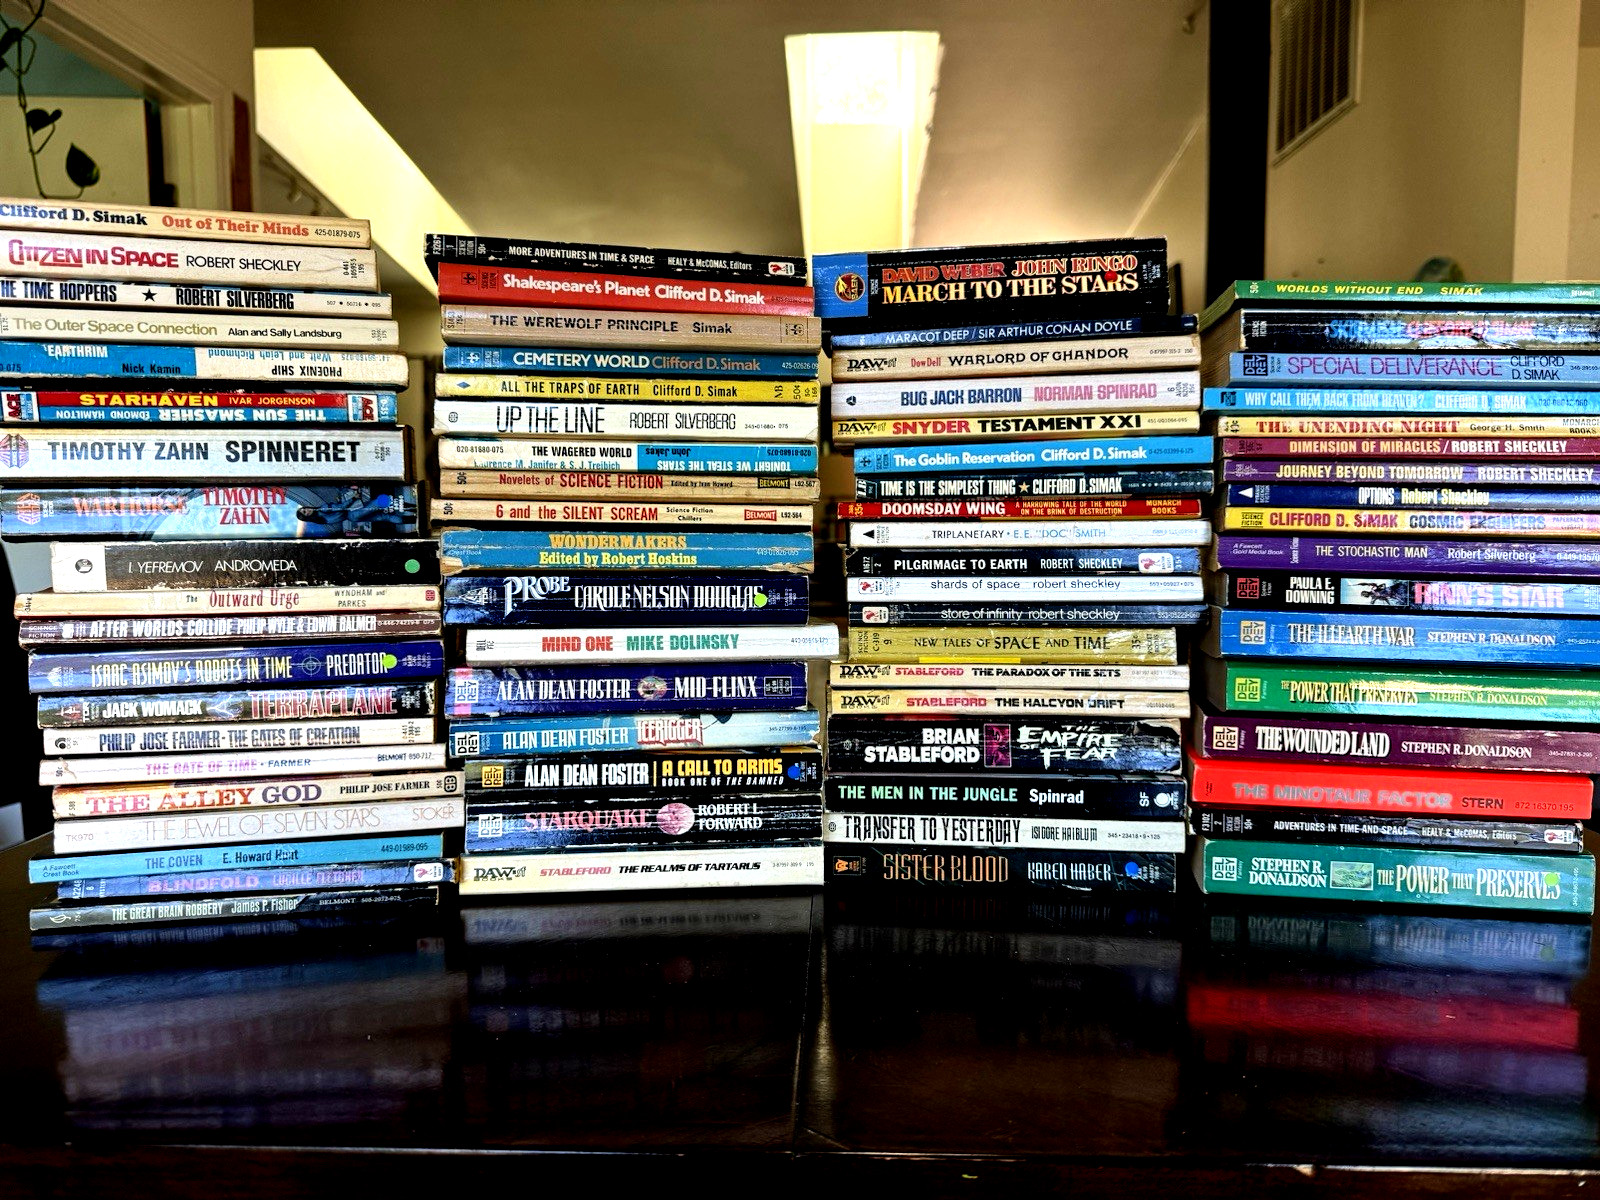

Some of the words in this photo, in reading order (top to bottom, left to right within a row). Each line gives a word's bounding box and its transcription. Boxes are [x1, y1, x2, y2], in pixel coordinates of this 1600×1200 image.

[162, 215, 191, 229] Out
[196, 217, 212, 230] of
[216, 219, 259, 233] Their
[263, 221, 309, 236] Minds
[315, 229, 360, 238] 425-01879-075
[509, 247, 532, 256] MORE
[535, 248, 587, 260] ADVENTURES
[589, 250, 598, 260] IN
[600, 251, 619, 261] TIME
[621, 253, 627, 262] &
[630, 254, 654, 265] SPACE
[186, 256, 235, 269] ROBERT
[239, 257, 301, 272] SHECKLEY
[503, 274, 601, 297] Shakespeare's
[605, 280, 650, 298] Planet
[1276, 285, 1327, 294] WORLDS
[1334, 286, 1392, 294] WITHOUT
[1397, 286, 1423, 295] END
[176, 290, 220, 307] ROBERT
[227, 291, 294, 309] SILVERBERG
[490, 315, 518, 327] THE
[523, 317, 602, 329] WEREWOLF
[608, 319, 678, 332] PRINCIPLE
[693, 322, 732, 334] Simak
[228, 328, 248, 336] Alan
[251, 328, 268, 337] and
[271, 328, 291, 339] Sally
[293, 328, 342, 339] Landsburg
[885, 330, 941, 344] MARACOT
[944, 329, 969, 340] DEEP
[979, 328, 996, 338] SIR
[999, 325, 1043, 337] ARTHUR
[1046, 323, 1091, 335] CONAN
[1094, 320, 1132, 332] DOYLE
[513, 352, 590, 368] CEMETERY
[594, 354, 649, 368] WORLD
[948, 352, 1026, 366] WARLORD
[1030, 352, 1049, 363] OF
[1052, 348, 1128, 362] GHANDOR
[122, 362, 144, 374] Nick
[150, 362, 180, 374] Kamin
[1288, 357, 1366, 375] SPECIAL
[1371, 358, 1502, 376] DELIVERANCE
[653, 384, 691, 396] Clifford
[695, 385, 704, 397] D.
[708, 385, 738, 398] Simak
[901, 391, 927, 406] BUG
[930, 390, 965, 405] JACK
[968, 388, 1021, 404] BARRON
[80, 393, 218, 406] STARHAVEN
[229, 395, 252, 405] IVAR
[258, 395, 315, 406] JORGENSON
[892, 421, 970, 435] SNYDER
[978, 417, 1094, 432] TESTAMENT
[1099, 415, 1141, 428] XXI
[1470, 424, 1501, 433] George
[1505, 424, 1515, 432] H.
[1519, 424, 1545, 432] Smith
[47, 442, 147, 460] TIMOTHY
[155, 442, 209, 459] ZAHN
[225, 441, 360, 463] SPINNERET
[456, 445, 503, 454] 020-81680-075
[532, 446, 550, 456] THE
[553, 446, 596, 457] WAGERED
[599, 447, 632, 458] WORLD
[894, 454, 916, 466] The
[919, 452, 959, 465] Goblin
[962, 450, 1035, 464] Reservation
[1276, 465, 1332, 479] JOURNEY
[1336, 466, 1386, 479] BEYOND
[1390, 466, 1463, 480] TOMORROW
[499, 474, 540, 486] Novelets
[543, 475, 554, 486] of
[560, 474, 613, 488] SCIENCE
[618, 475, 663, 489] FICTION
[881, 481, 902, 495] TIME
[906, 481, 915, 494] IS
[919, 481, 935, 495] THE
[939, 479, 985, 494] SIMPLEST
[988, 479, 1016, 493] THING
[1358, 488, 1394, 505] OPTIONS
[745, 511, 776, 520] BELMONT
[781, 511, 802, 519] L92-564
[1270, 513, 1330, 526] CLIFFORD
[1336, 514, 1349, 527] D.
[1354, 515, 1398, 528] SIMAK
[932, 529, 1004, 540] TRIPLANETARY
[539, 552, 580, 565] Edited
[583, 552, 598, 566] by
[601, 552, 644, 565] Robert
[648, 552, 697, 565] Hoskins
[1316, 546, 1333, 557] THE
[1338, 546, 1400, 558] STOCHASTIC
[1404, 547, 1428, 558] MAN
[215, 559, 297, 571] ANDROMEDA
[894, 558, 967, 570] PILGRIMAGE
[970, 559, 985, 569] TO
[989, 558, 1027, 569] EARTH
[931, 579, 968, 590] shards
[972, 579, 984, 590] of
[987, 581, 1020, 592] space
[1290, 577, 1319, 590] PAULA
[1322, 578, 1334, 591] E.
[1285, 590, 1334, 604] DOWNING
[542, 636, 581, 651] MIND
[585, 636, 613, 651] ONE
[627, 635, 664, 650] MIKE
[670, 633, 739, 650] DOLINSKY
[895, 667, 964, 676] STABLEFORD
[923, 729, 979, 744] BRIAN
[864, 747, 979, 762] STABLEFORD
[663, 761, 672, 775] A
[678, 760, 711, 775] CALL
[714, 759, 732, 774] TO
[737, 758, 782, 774] ARMS
[339, 783, 369, 794] PHILIP
[372, 782, 393, 793] JOSE
[396, 780, 430, 792] FARMER
[1029, 789, 1084, 806] Spinrad
[1140, 791, 1149, 807] SF
[1462, 798, 1503, 808] STERN
[698, 804, 750, 816] ROBERT
[754, 804, 763, 815] L.
[1560, 803, 1573, 811] 195
[698, 817, 762, 830] FORWARD
[66, 833, 94, 842] TK970
[145, 857, 164, 869] THE
[168, 855, 202, 867] COVEN
[618, 864, 639, 873] THE
[642, 864, 685, 873] REALMS
[705, 862, 761, 871] TARTARUS
[1252, 858, 1309, 872] STEPHEN
[1313, 859, 1324, 873] R.
[1249, 873, 1327, 888] DONALDSON
[231, 901, 257, 914] James
[260, 900, 270, 913] P.
[271, 897, 298, 911] Fisher
